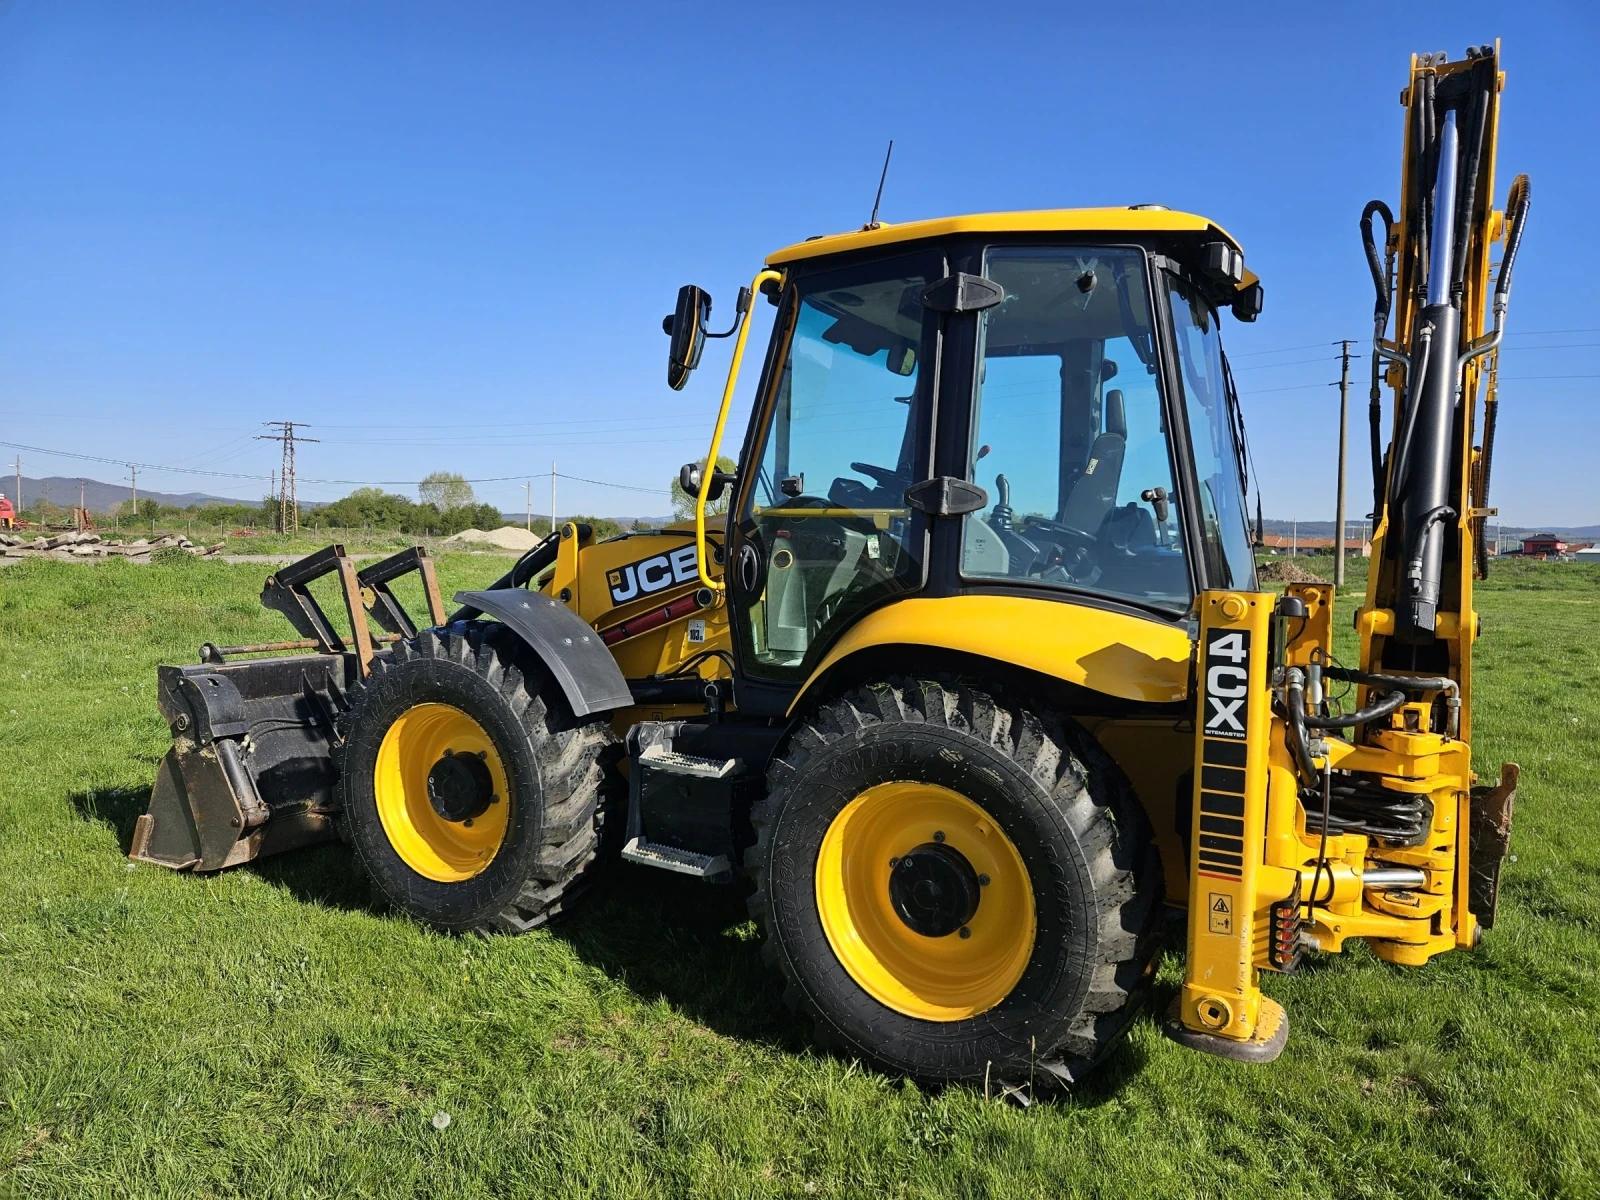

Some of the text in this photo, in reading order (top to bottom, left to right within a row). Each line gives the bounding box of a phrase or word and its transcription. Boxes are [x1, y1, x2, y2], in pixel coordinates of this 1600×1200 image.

[613, 545, 699, 602] JCB
[690, 630, 700, 641] 103
[1205, 633, 1248, 730] 4CX
[1204, 729, 1246, 738] SITEMASTER
